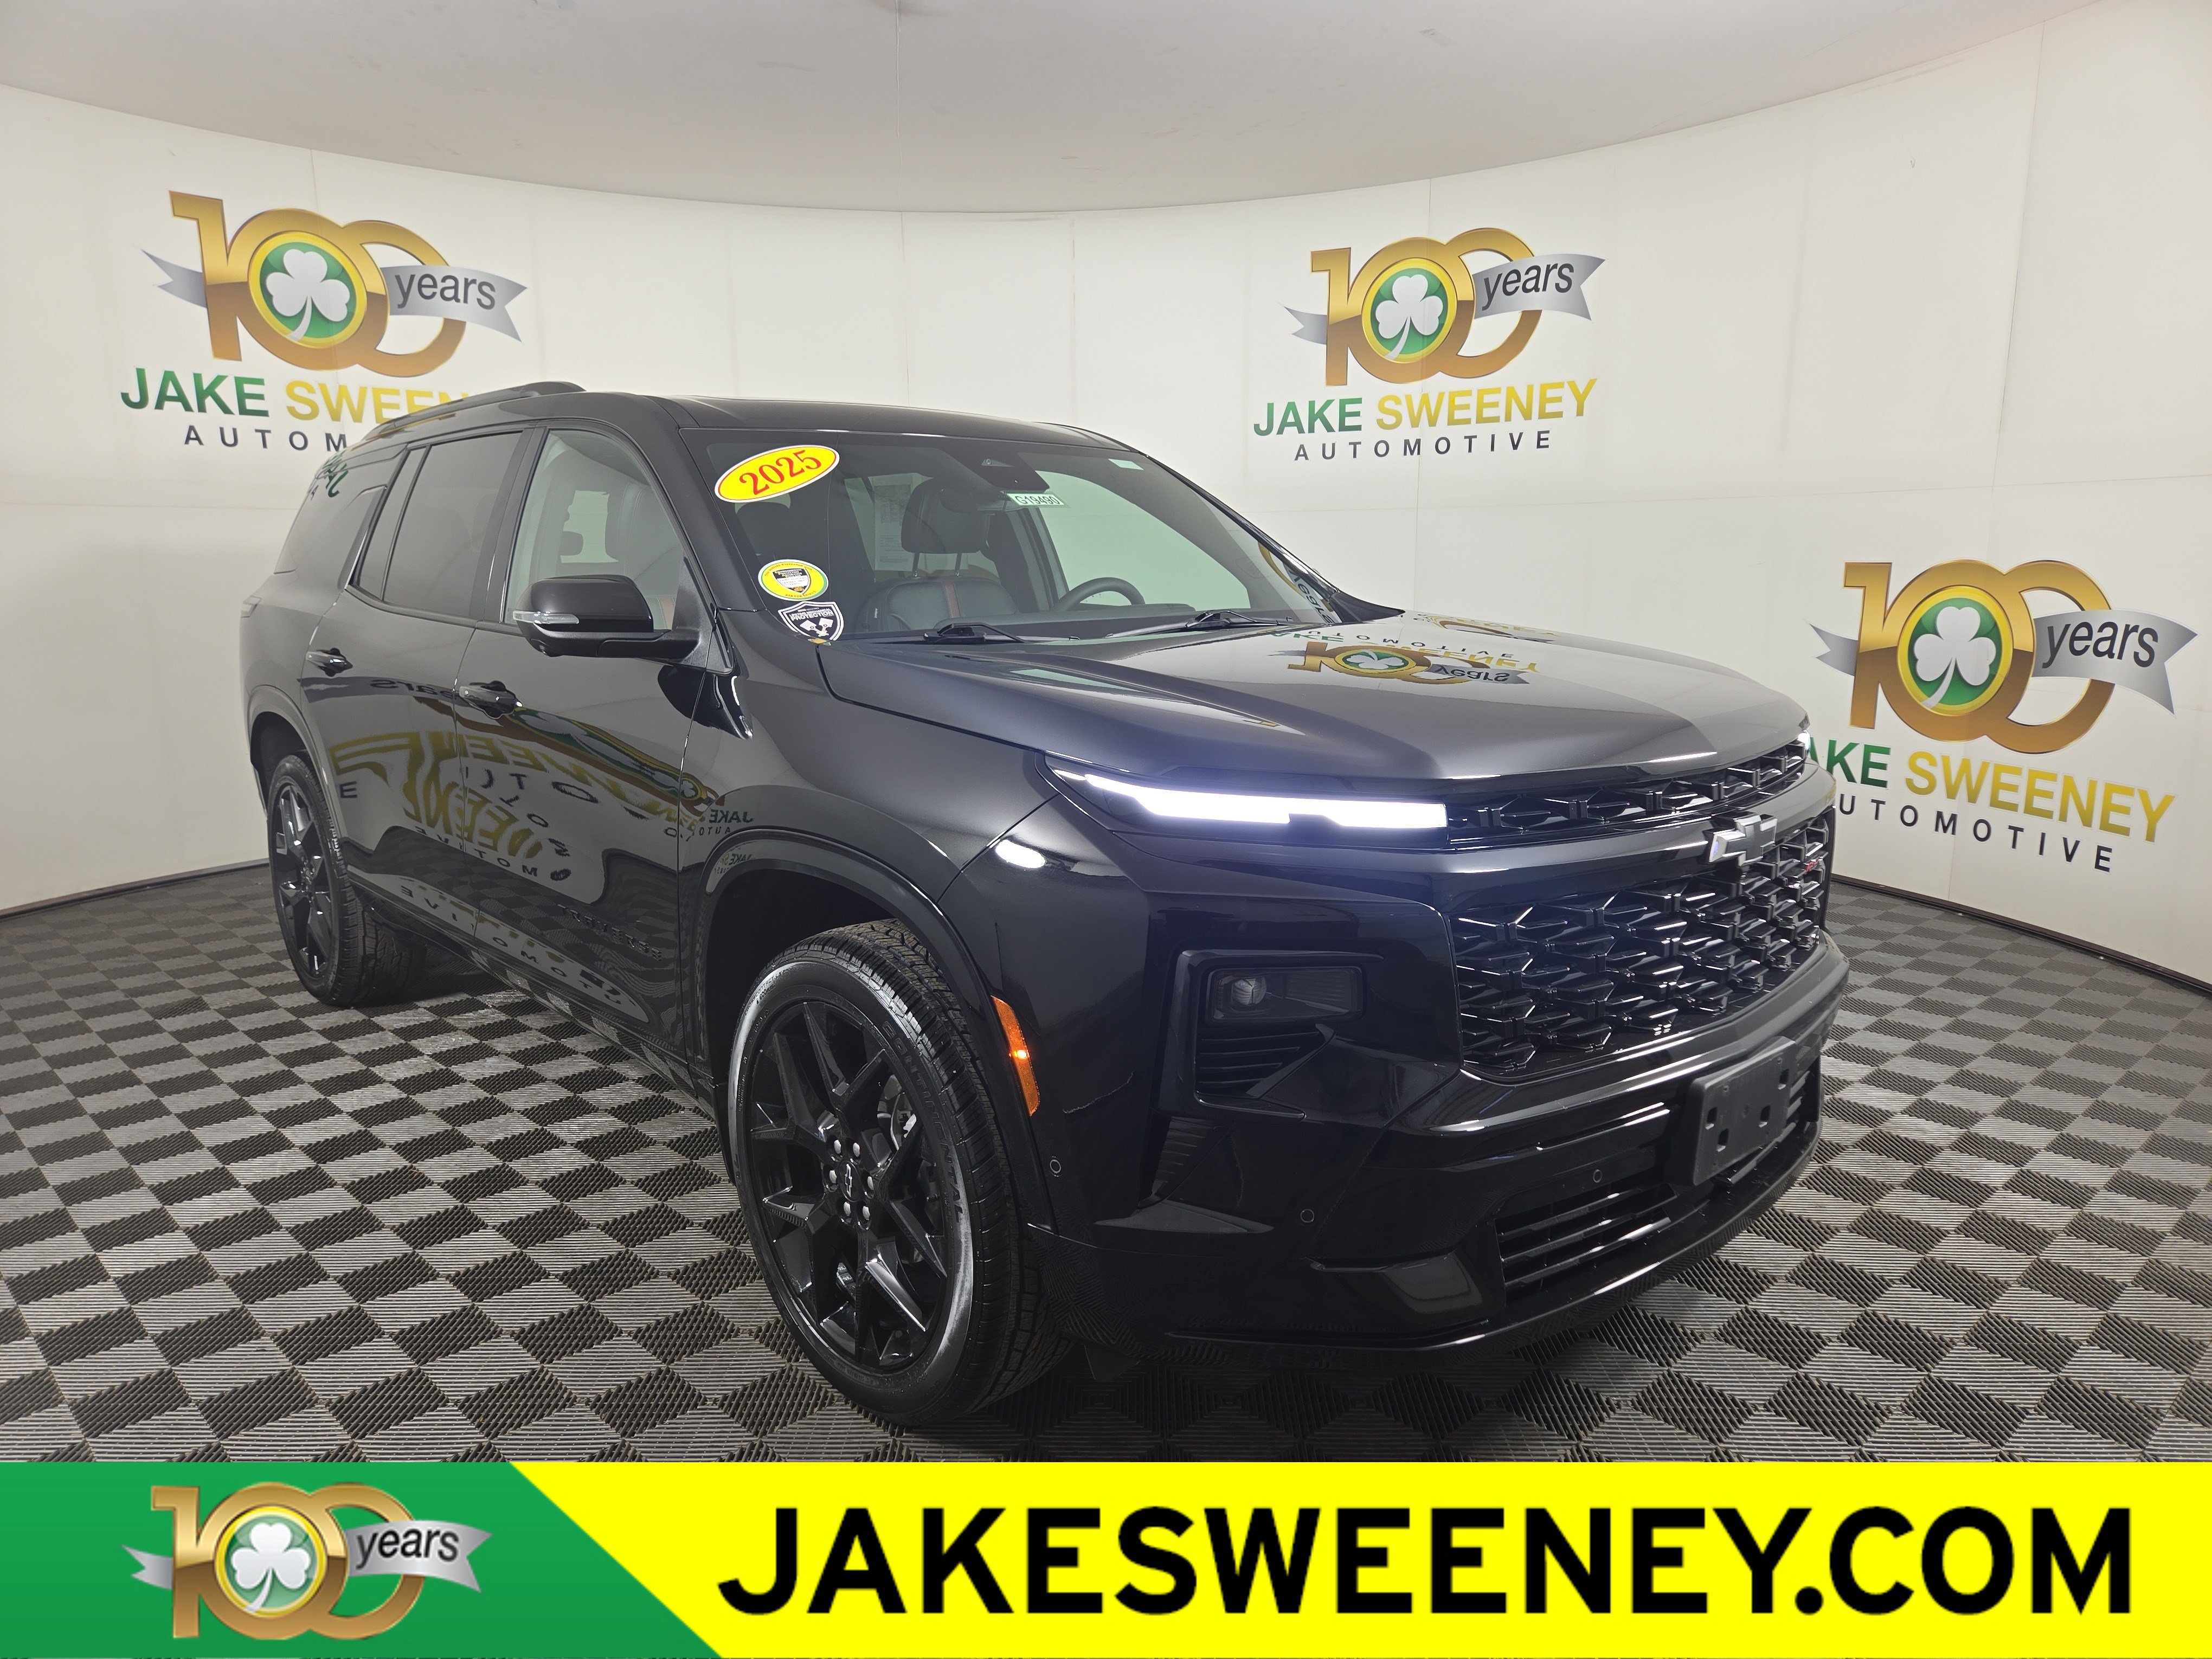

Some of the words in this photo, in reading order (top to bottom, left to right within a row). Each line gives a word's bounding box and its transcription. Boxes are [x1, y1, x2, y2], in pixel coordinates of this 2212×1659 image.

[395, 273, 496, 310] years
[1481, 263, 1574, 311] years
[121, 368, 269, 417] JAKE
[1254, 397, 1362, 436] JAKE
[1376, 379, 1598, 430] SWEENEY
[184, 425, 347, 452] AUTOM
[1294, 430, 1550, 461] AUTOMOTIVE
[740, 450, 821, 495] 2025
[1015, 496, 1060, 505] G19490
[2042, 621, 2158, 668] years
[1905, 751, 2175, 842] SWEENEY
[1840, 793, 2112, 872] UTOMOTIVE
